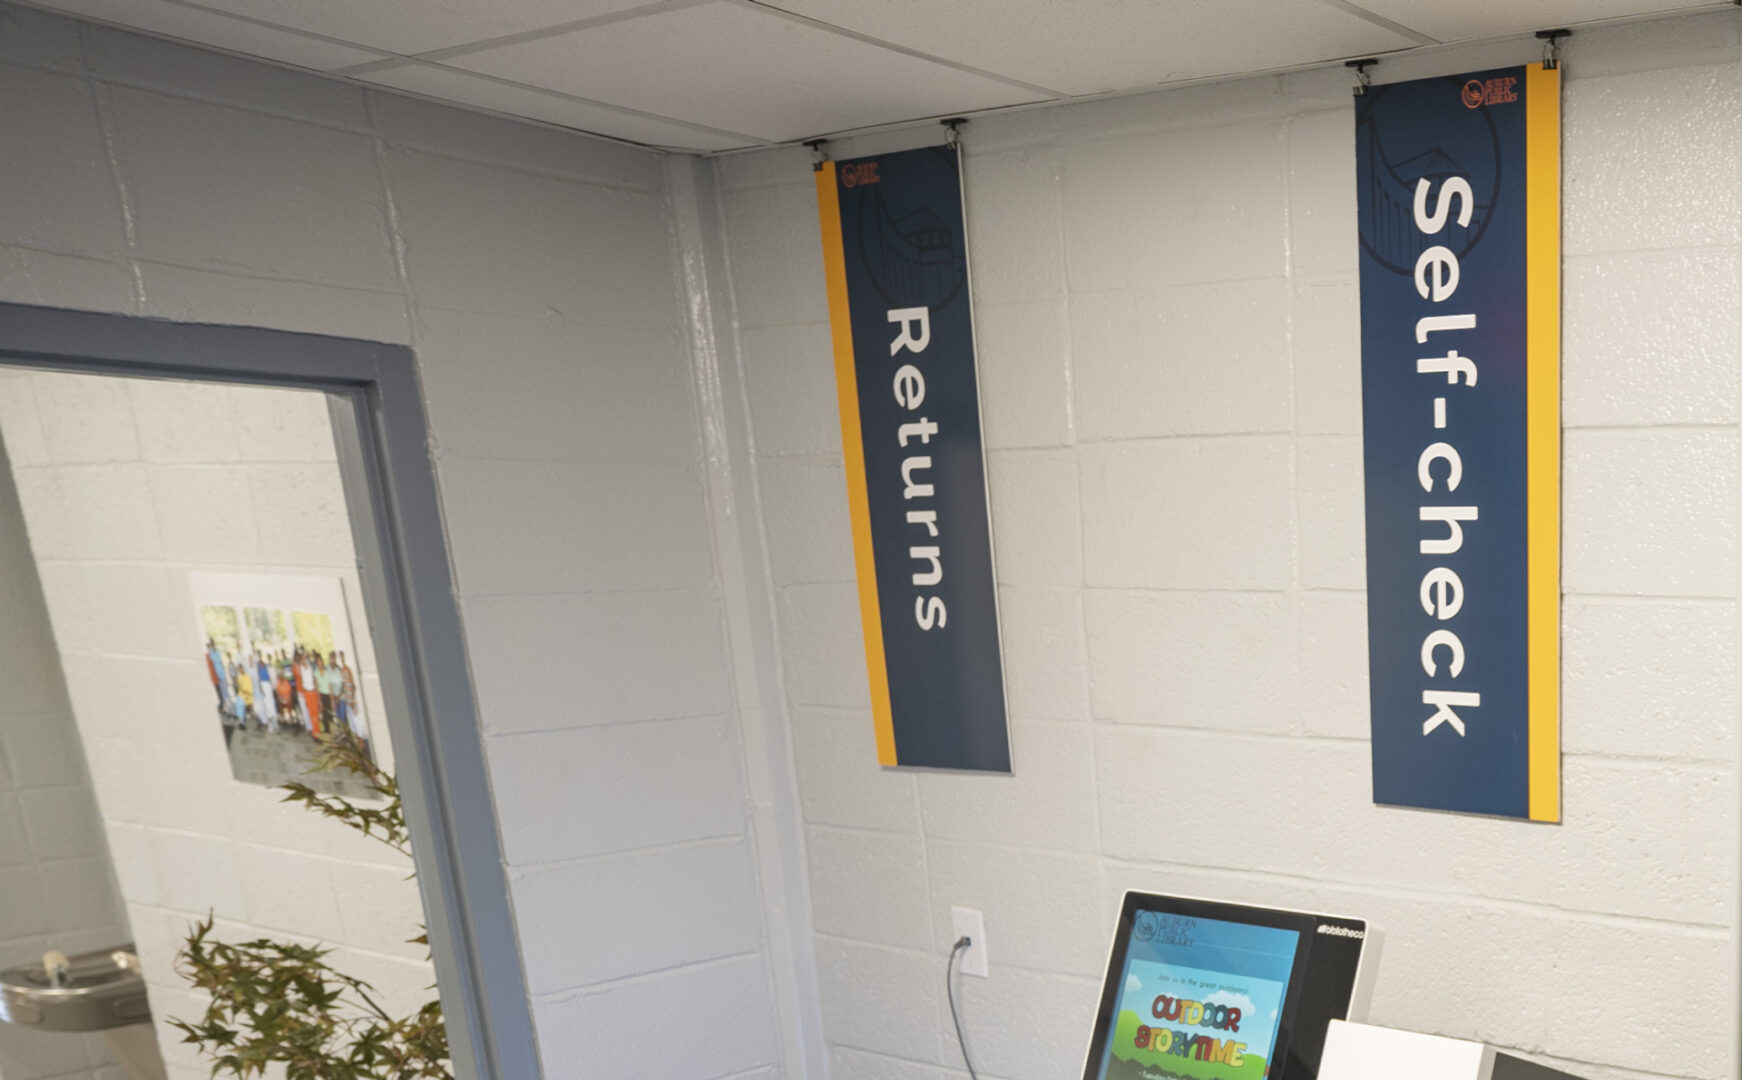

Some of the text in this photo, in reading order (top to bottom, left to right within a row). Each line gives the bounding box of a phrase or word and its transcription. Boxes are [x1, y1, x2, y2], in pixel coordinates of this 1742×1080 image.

[886, 305, 947, 632] Returns
[1412, 175, 1480, 738] Self-check
[1156, 933, 1195, 948] LIBRARY
[1161, 915, 1197, 929] AUBURN
[1152, 994, 1242, 1033] OUTDOOR
[1134, 1025, 1248, 1068] STORYTIME
